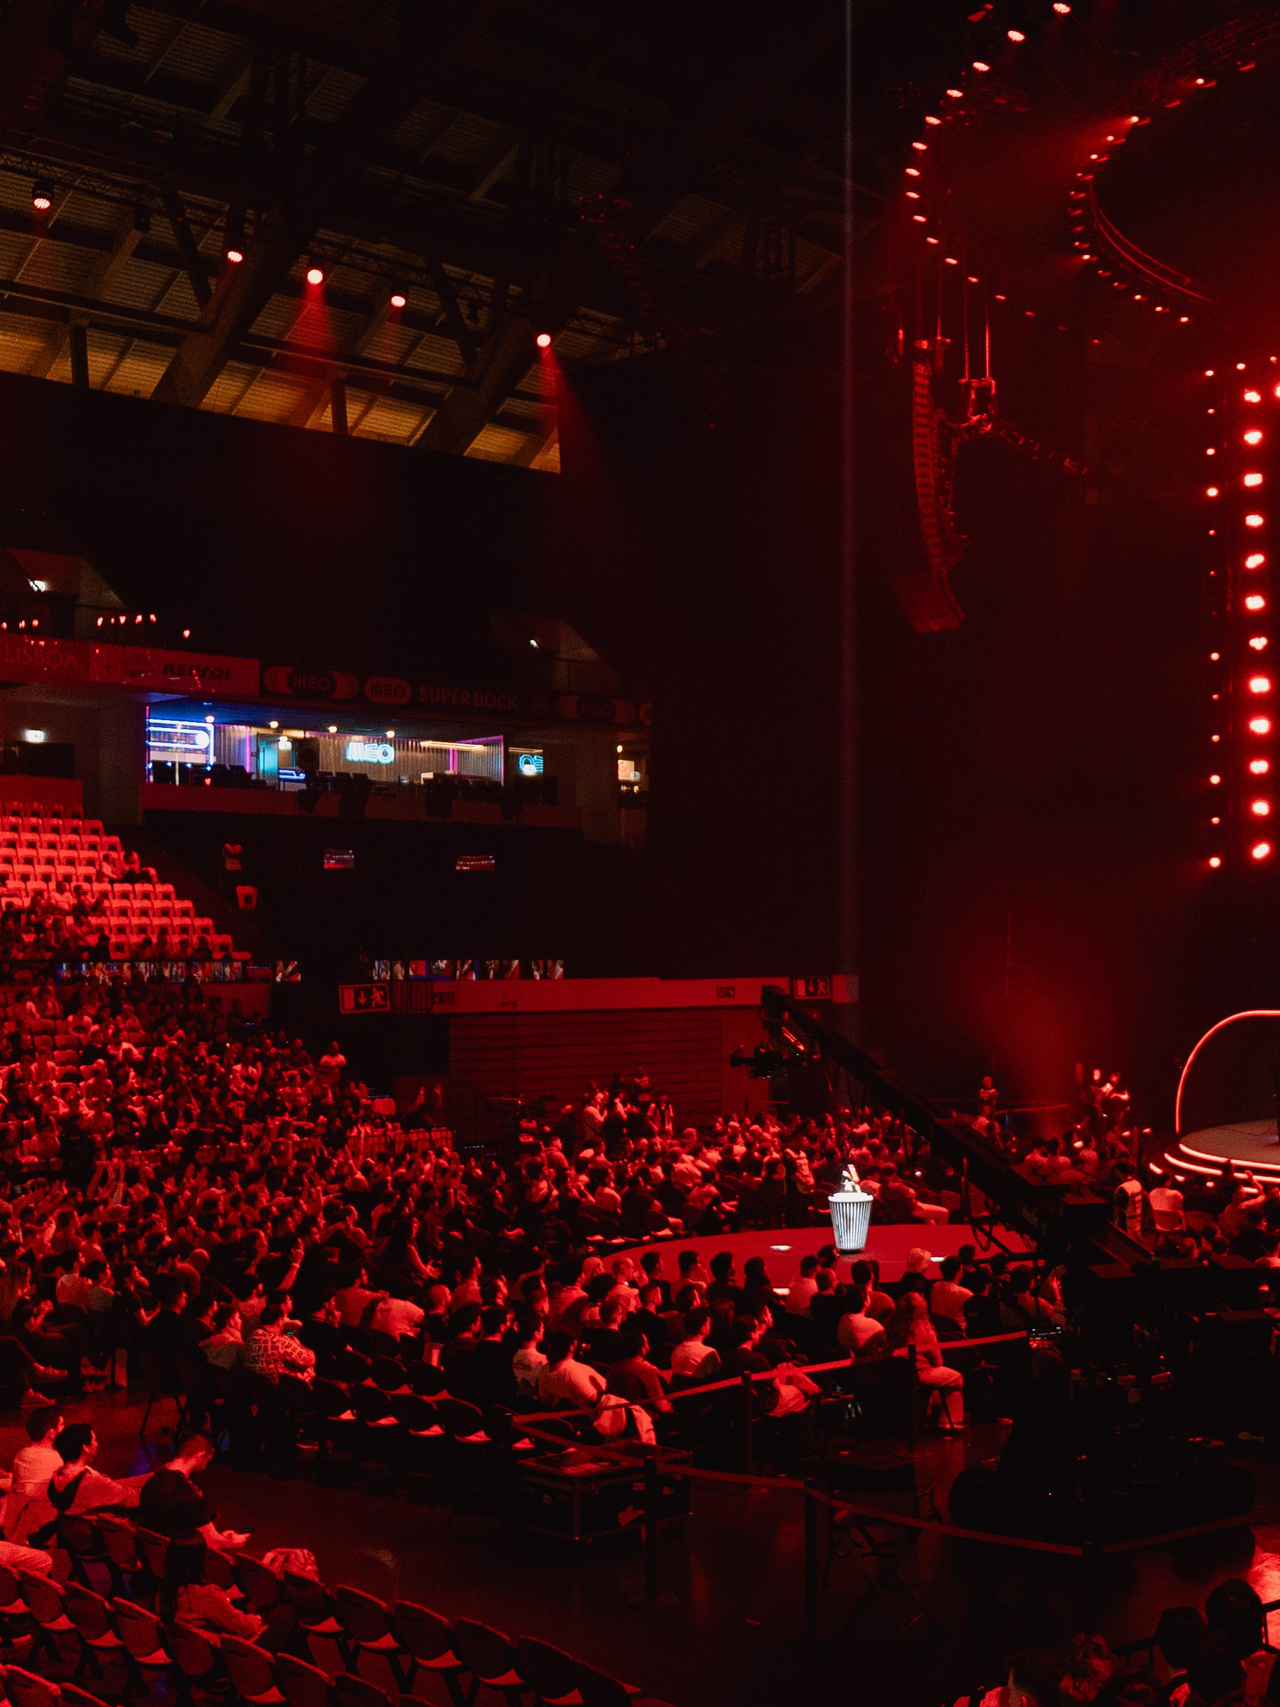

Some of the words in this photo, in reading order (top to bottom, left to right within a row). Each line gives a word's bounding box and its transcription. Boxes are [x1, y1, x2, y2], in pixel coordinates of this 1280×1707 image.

[293, 674, 331, 690] MEO
[371, 683, 406, 699] MEO
[418, 685, 472, 707] SUPER
[473, 691, 518, 711] BOCK
[345, 741, 395, 764] MEO
